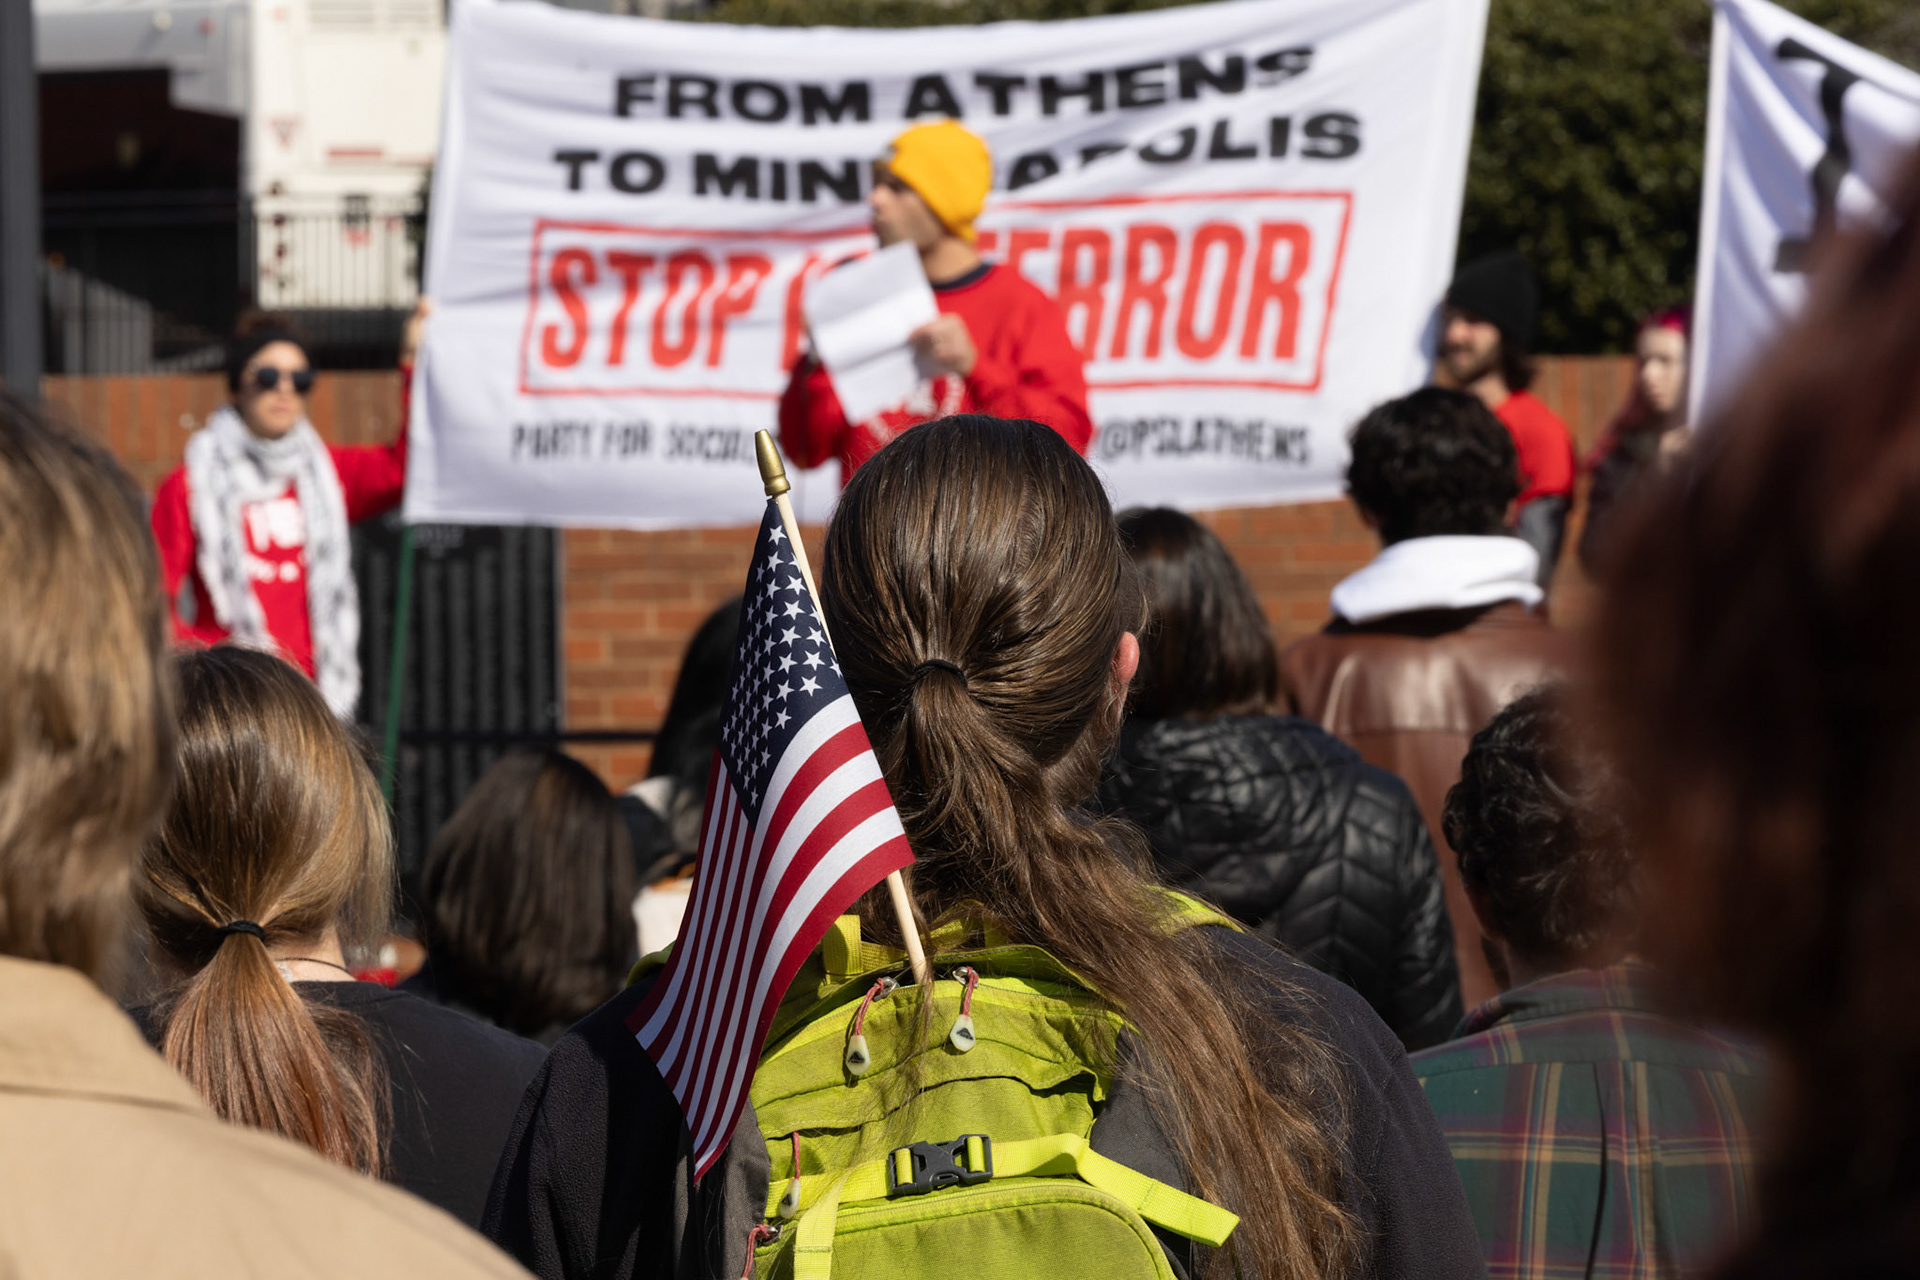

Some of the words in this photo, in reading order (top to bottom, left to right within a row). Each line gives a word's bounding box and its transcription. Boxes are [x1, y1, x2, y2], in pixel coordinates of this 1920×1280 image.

[614, 74, 870, 125] FROM
[904, 46, 1315, 119] ATHENS
[553, 149, 666, 194] TO
[695, 112, 1362, 203] MINAOLIS
[541, 247, 772, 370] STOP
[976, 219, 1311, 361] RROR
[514, 423, 591, 459] PARTY
[604, 421, 650, 456] FOR
[1101, 417, 1311, 466] @PSLATHENS
